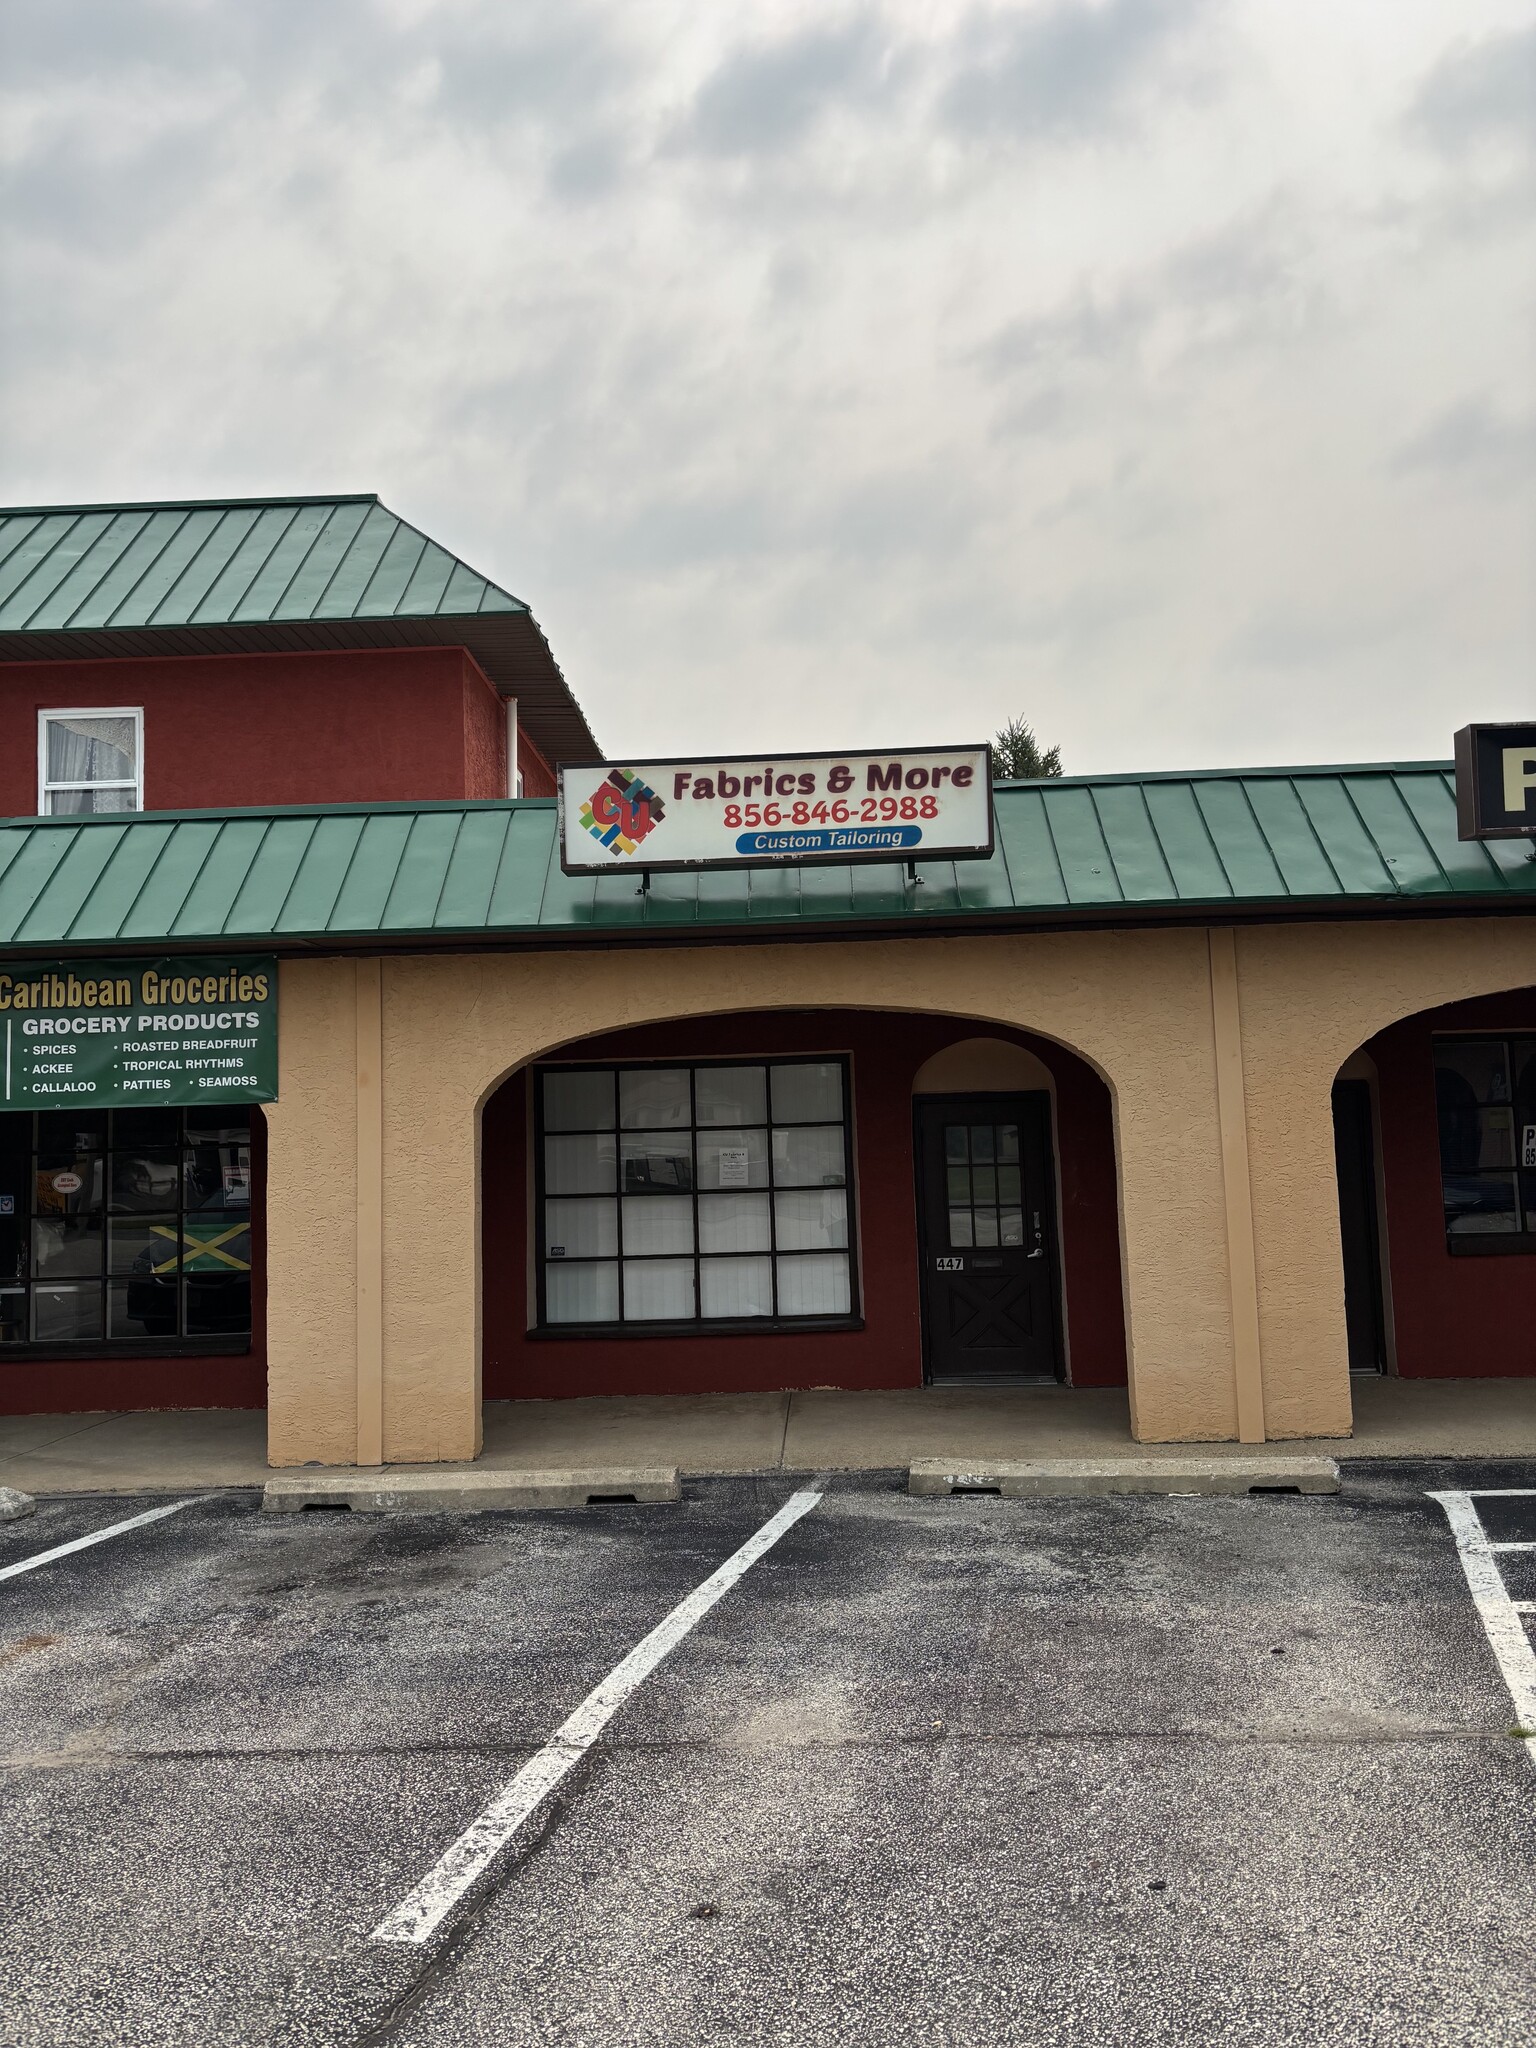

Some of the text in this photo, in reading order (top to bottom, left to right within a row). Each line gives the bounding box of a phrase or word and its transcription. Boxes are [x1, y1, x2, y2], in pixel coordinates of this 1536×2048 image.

[674, 763, 973, 801] Fabrics & More
[724, 796, 938, 828] 856-846-2988
[754, 830, 904, 849] Custom Tailoring
[0, 969, 268, 1010] Caribbean Groceries
[22, 1012, 260, 1036] GROCERY PRODUCTS
[32, 1044, 77, 1055] SPICES
[123, 1038, 258, 1052] ROASTED BREADFRUIT
[32, 1063, 73, 1074] ACKEE
[123, 1057, 244, 1071] TROPICAL RHYTHMS
[32, 1081, 96, 1093] CALLALOO
[123, 1079, 171, 1090] PATTIES
[198, 1076, 258, 1088] SEAMOSS
[938, 1258, 962, 1270] 447
